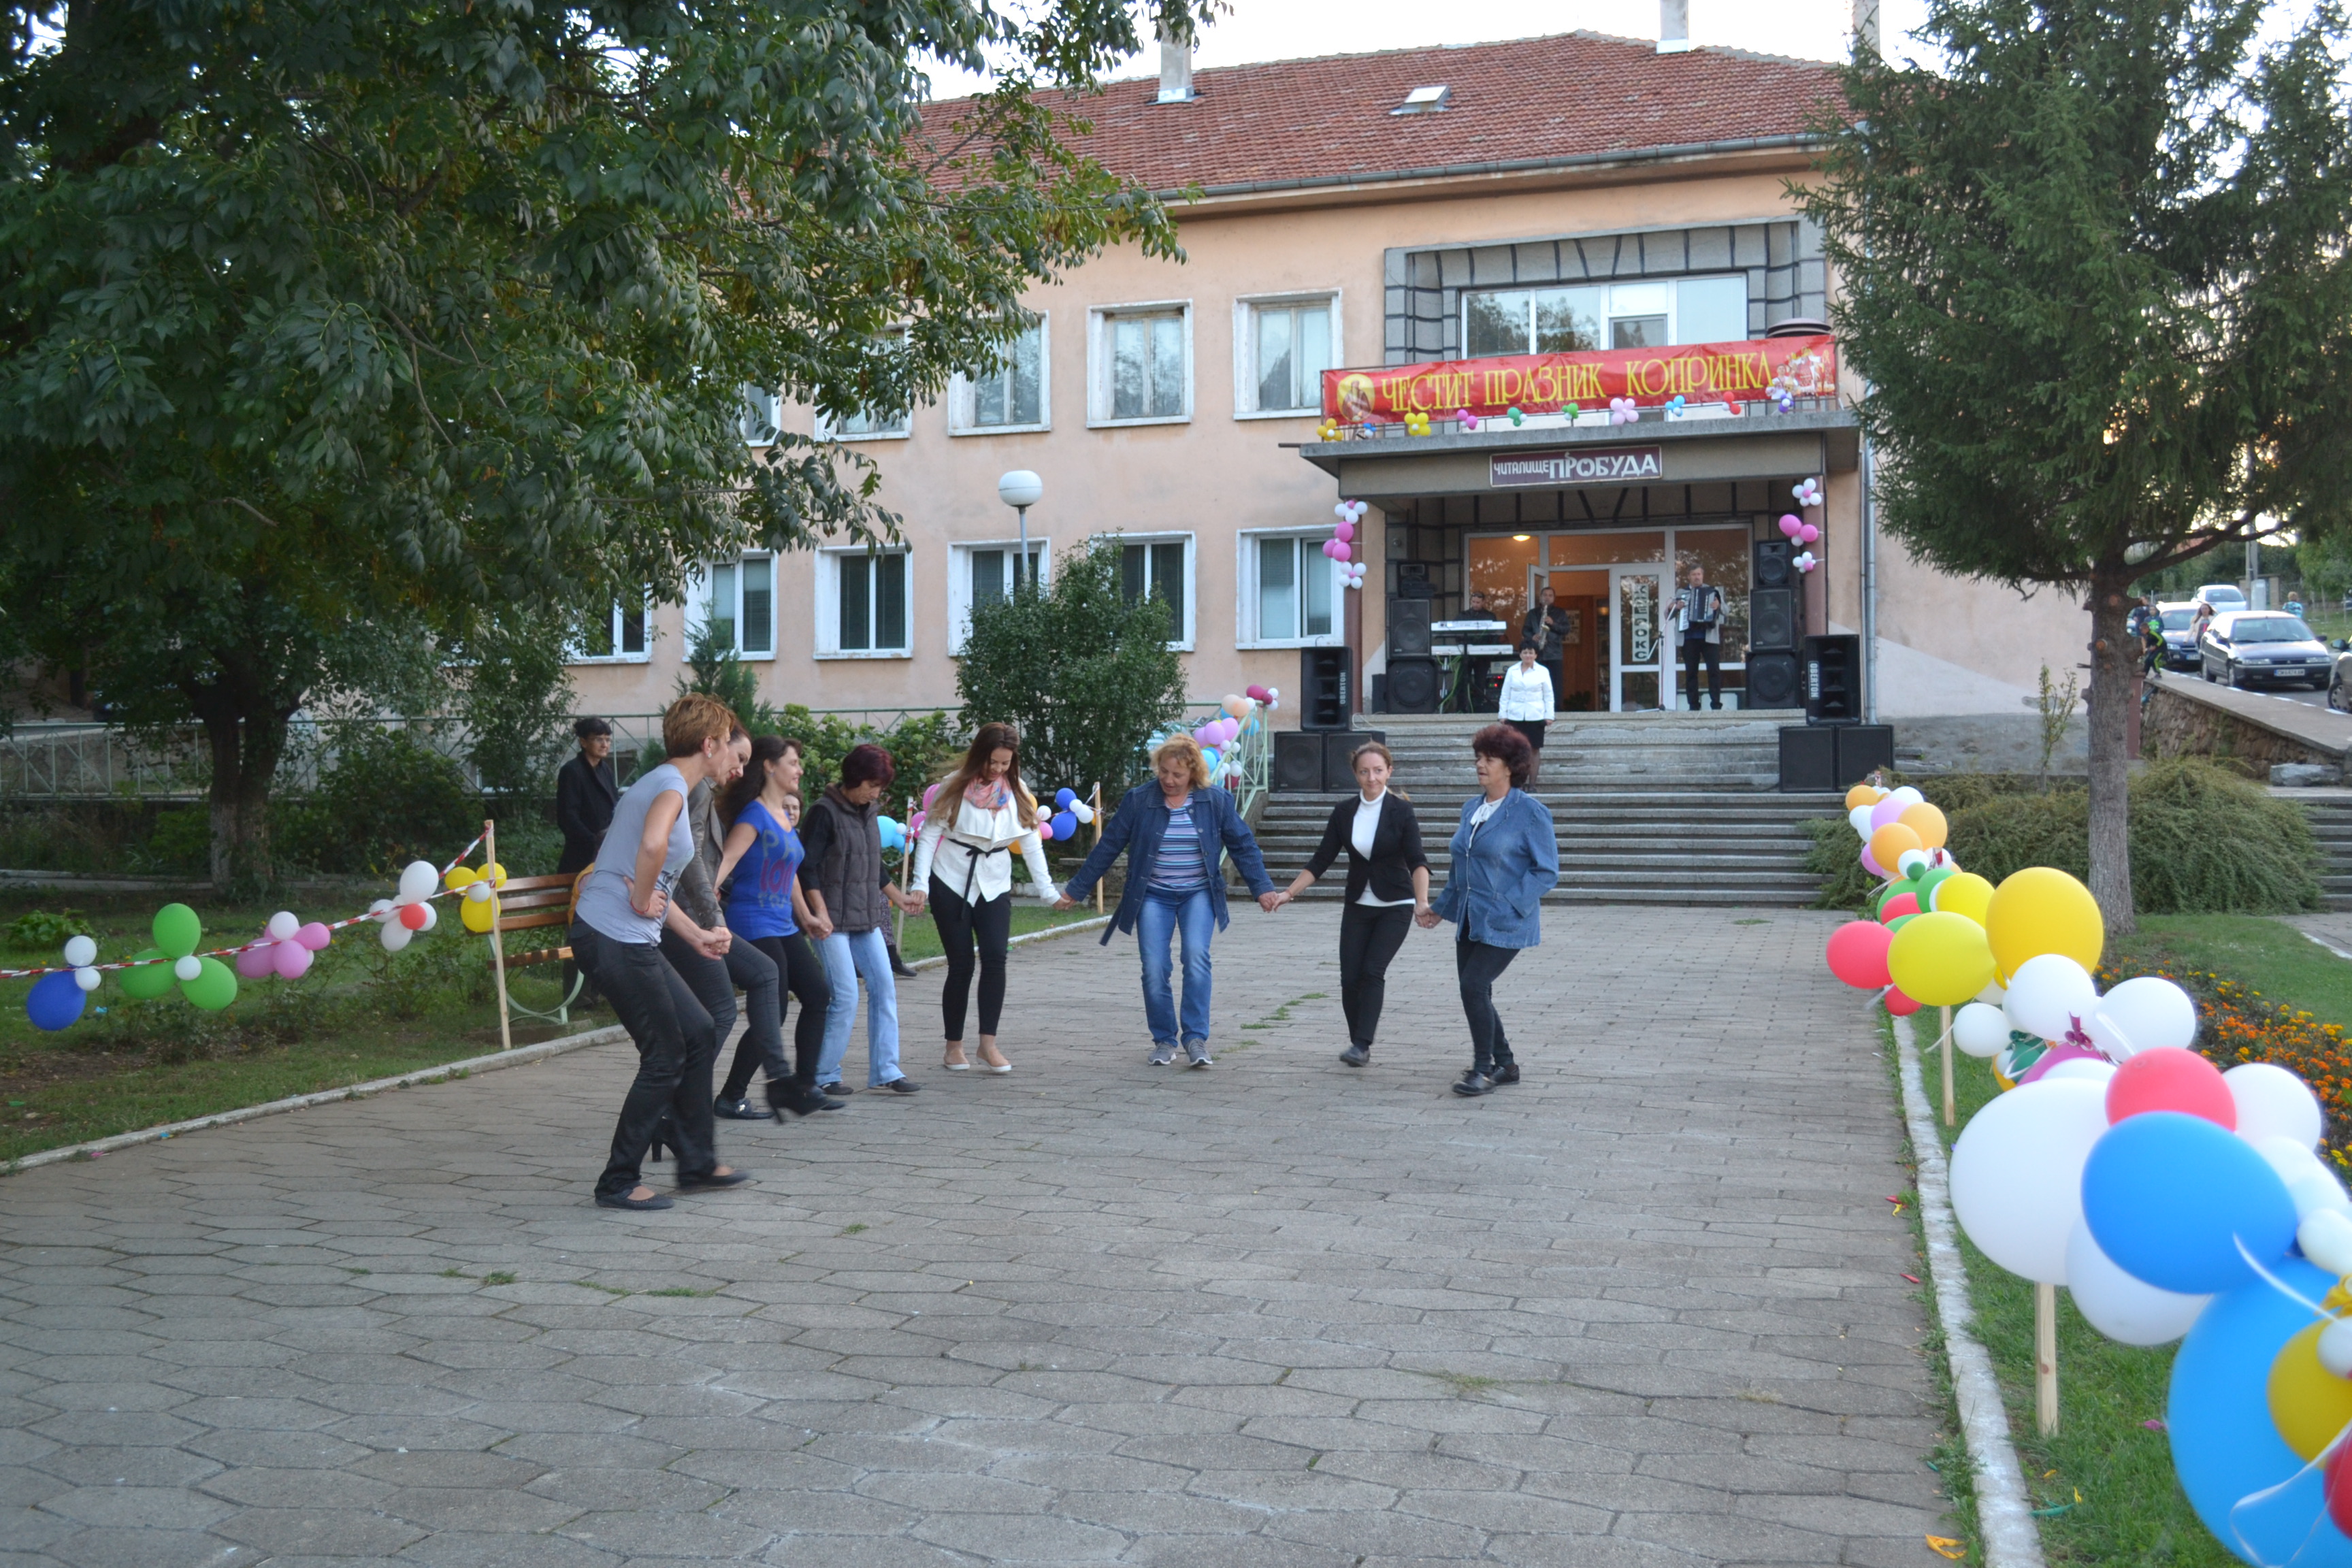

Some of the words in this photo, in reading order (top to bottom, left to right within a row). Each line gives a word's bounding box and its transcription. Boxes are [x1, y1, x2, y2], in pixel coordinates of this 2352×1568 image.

[1382, 370, 1474, 412] ЧЕСТИТ
[1484, 363, 1607, 406] ПРАЗНИК
[1625, 350, 1775, 397] КОПРИНКА
[1494, 459, 1550, 476] ЧИТАЛИЩЕ
[1549, 452, 1659, 479] ПРОБУДА
[1810, 663, 1819, 698] OBERTON
